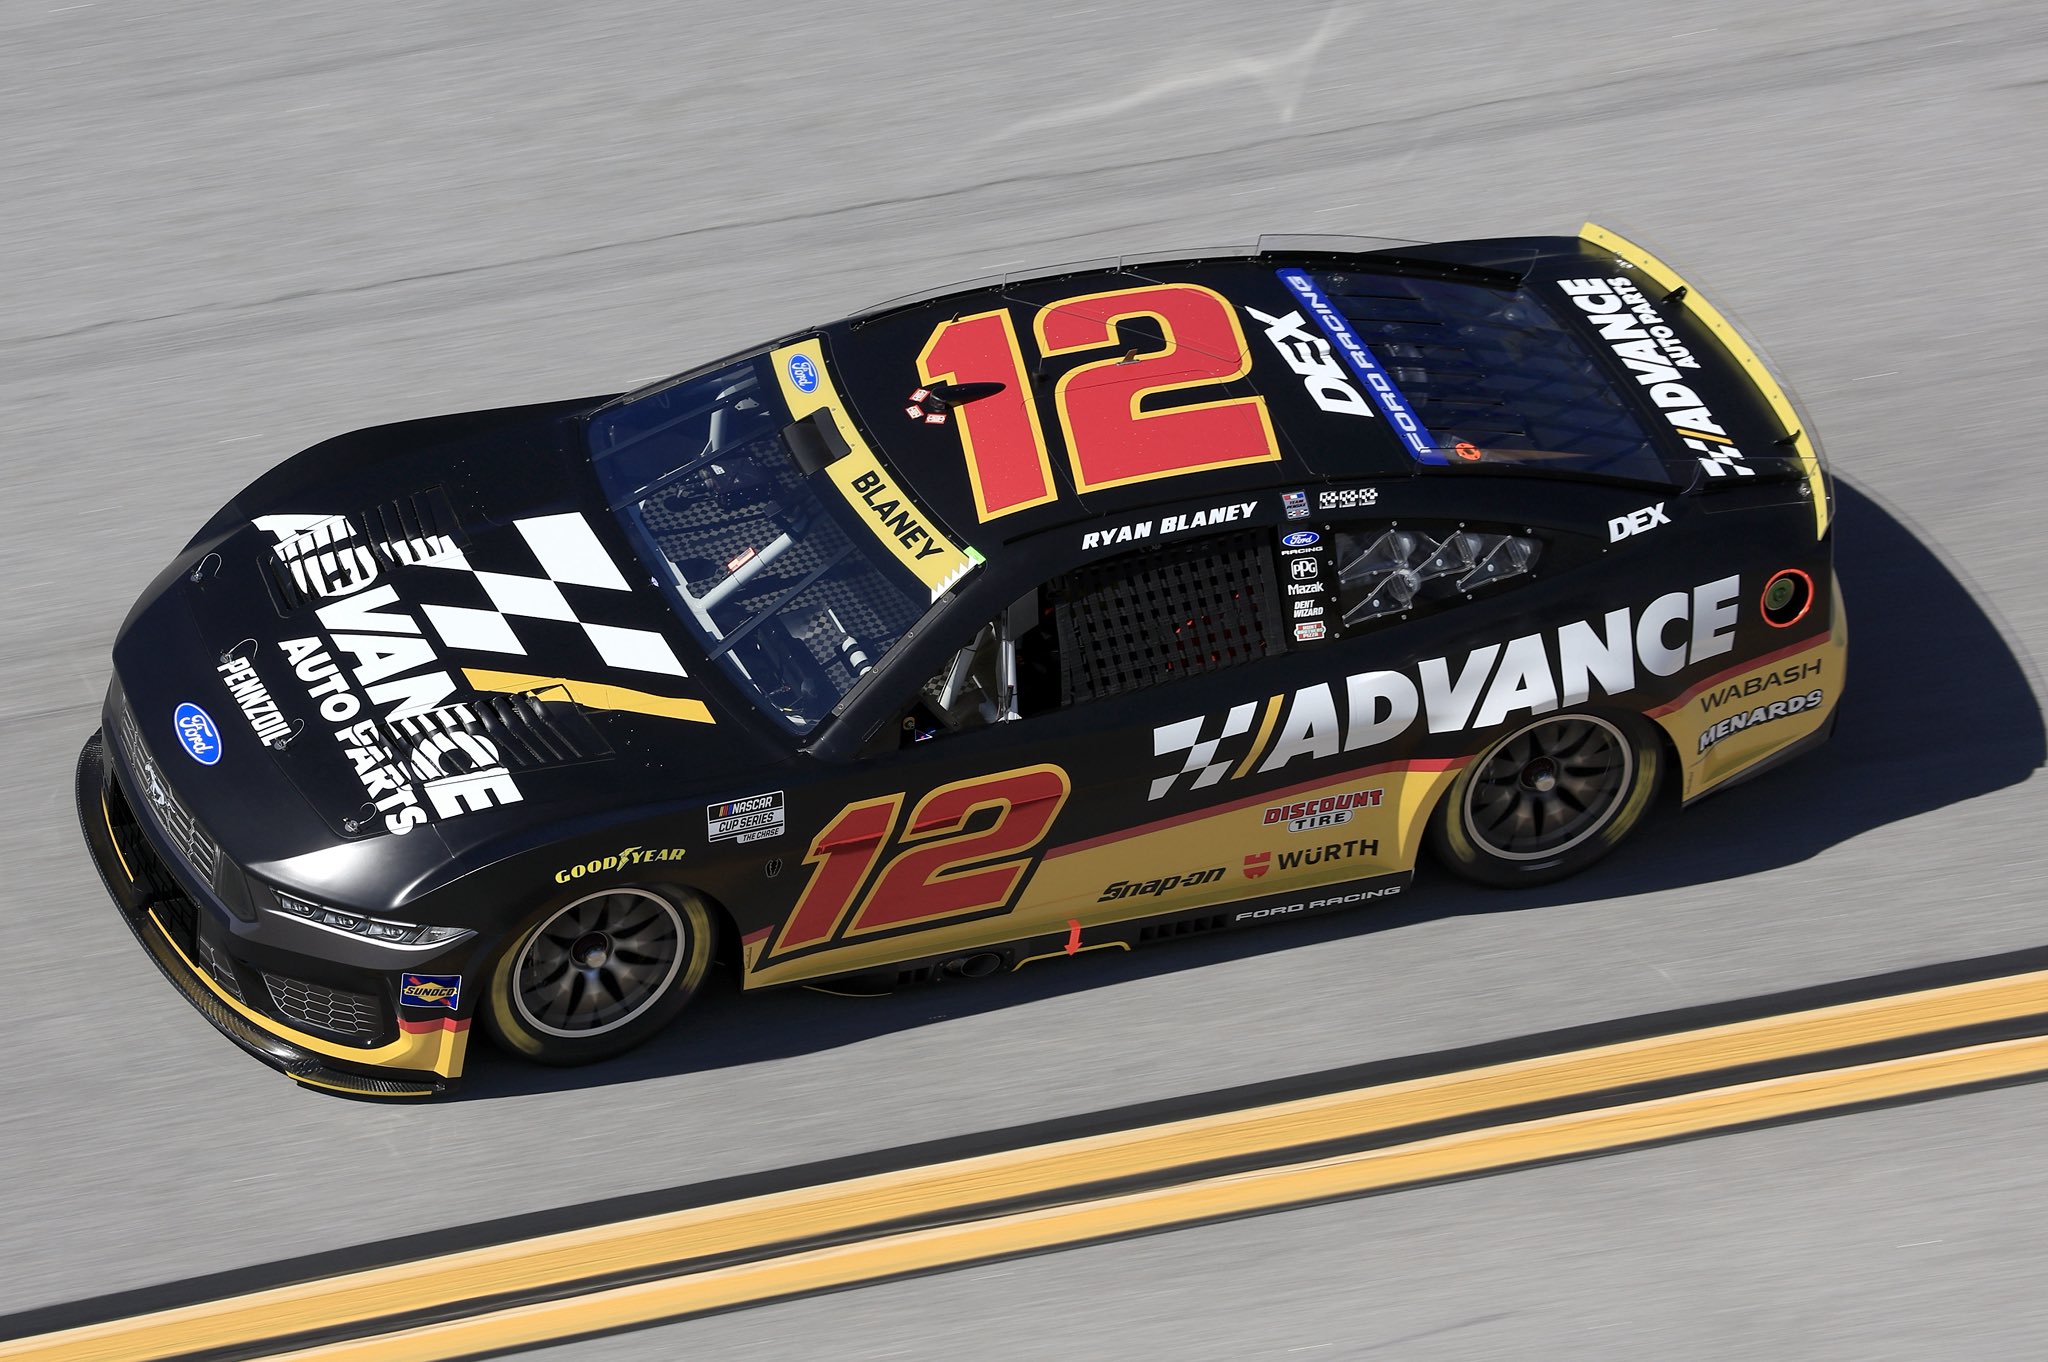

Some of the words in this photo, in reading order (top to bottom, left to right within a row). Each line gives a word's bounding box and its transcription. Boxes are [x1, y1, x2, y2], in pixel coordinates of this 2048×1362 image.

[1286, 275, 1375, 370] RACING
[1606, 276, 1665, 325] PARTS
[1244, 305, 1375, 418] DEX
[1556, 277, 1728, 436] ADVANCE
[1649, 325, 1702, 370] AUTO
[915, 283, 1282, 525] 12
[1366, 373, 1433, 454] FORD
[851, 470, 945, 560] BLANEY
[1082, 521, 1153, 551] RYAN
[1159, 501, 1258, 535] BLANEY
[1608, 501, 1672, 544] DEX
[1281, 546, 1324, 556] RACING
[1287, 581, 1325, 596] Mazak
[1293, 606, 1324, 618] WIZARD
[1294, 600, 1316, 610] DENT
[251, 514, 524, 820] ADVANCE
[1257, 574, 1741, 773] ADVANCE
[1700, 658, 1822, 713] WABASH
[217, 656, 292, 747] PENNZOIL
[1697, 689, 1824, 755] MENARDS
[278, 636, 361, 722] AUTO
[334, 719, 428, 836] PARTS
[718, 819, 740, 833] CUP
[739, 812, 775, 828] SERIES
[731, 796, 773, 815] NASCAR
[1263, 788, 1385, 826] DISCOUNT
[1295, 812, 1347, 830] TIRE
[742, 832, 756, 842] THE
[756, 827, 780, 839] CHASE
[767, 763, 1072, 960] 12
[1097, 867, 1227, 903] Snap-on
[1235, 903, 1304, 922] FORD
[1309, 886, 1401, 909] RACING
[405, 986, 456, 997] SUNOCO
